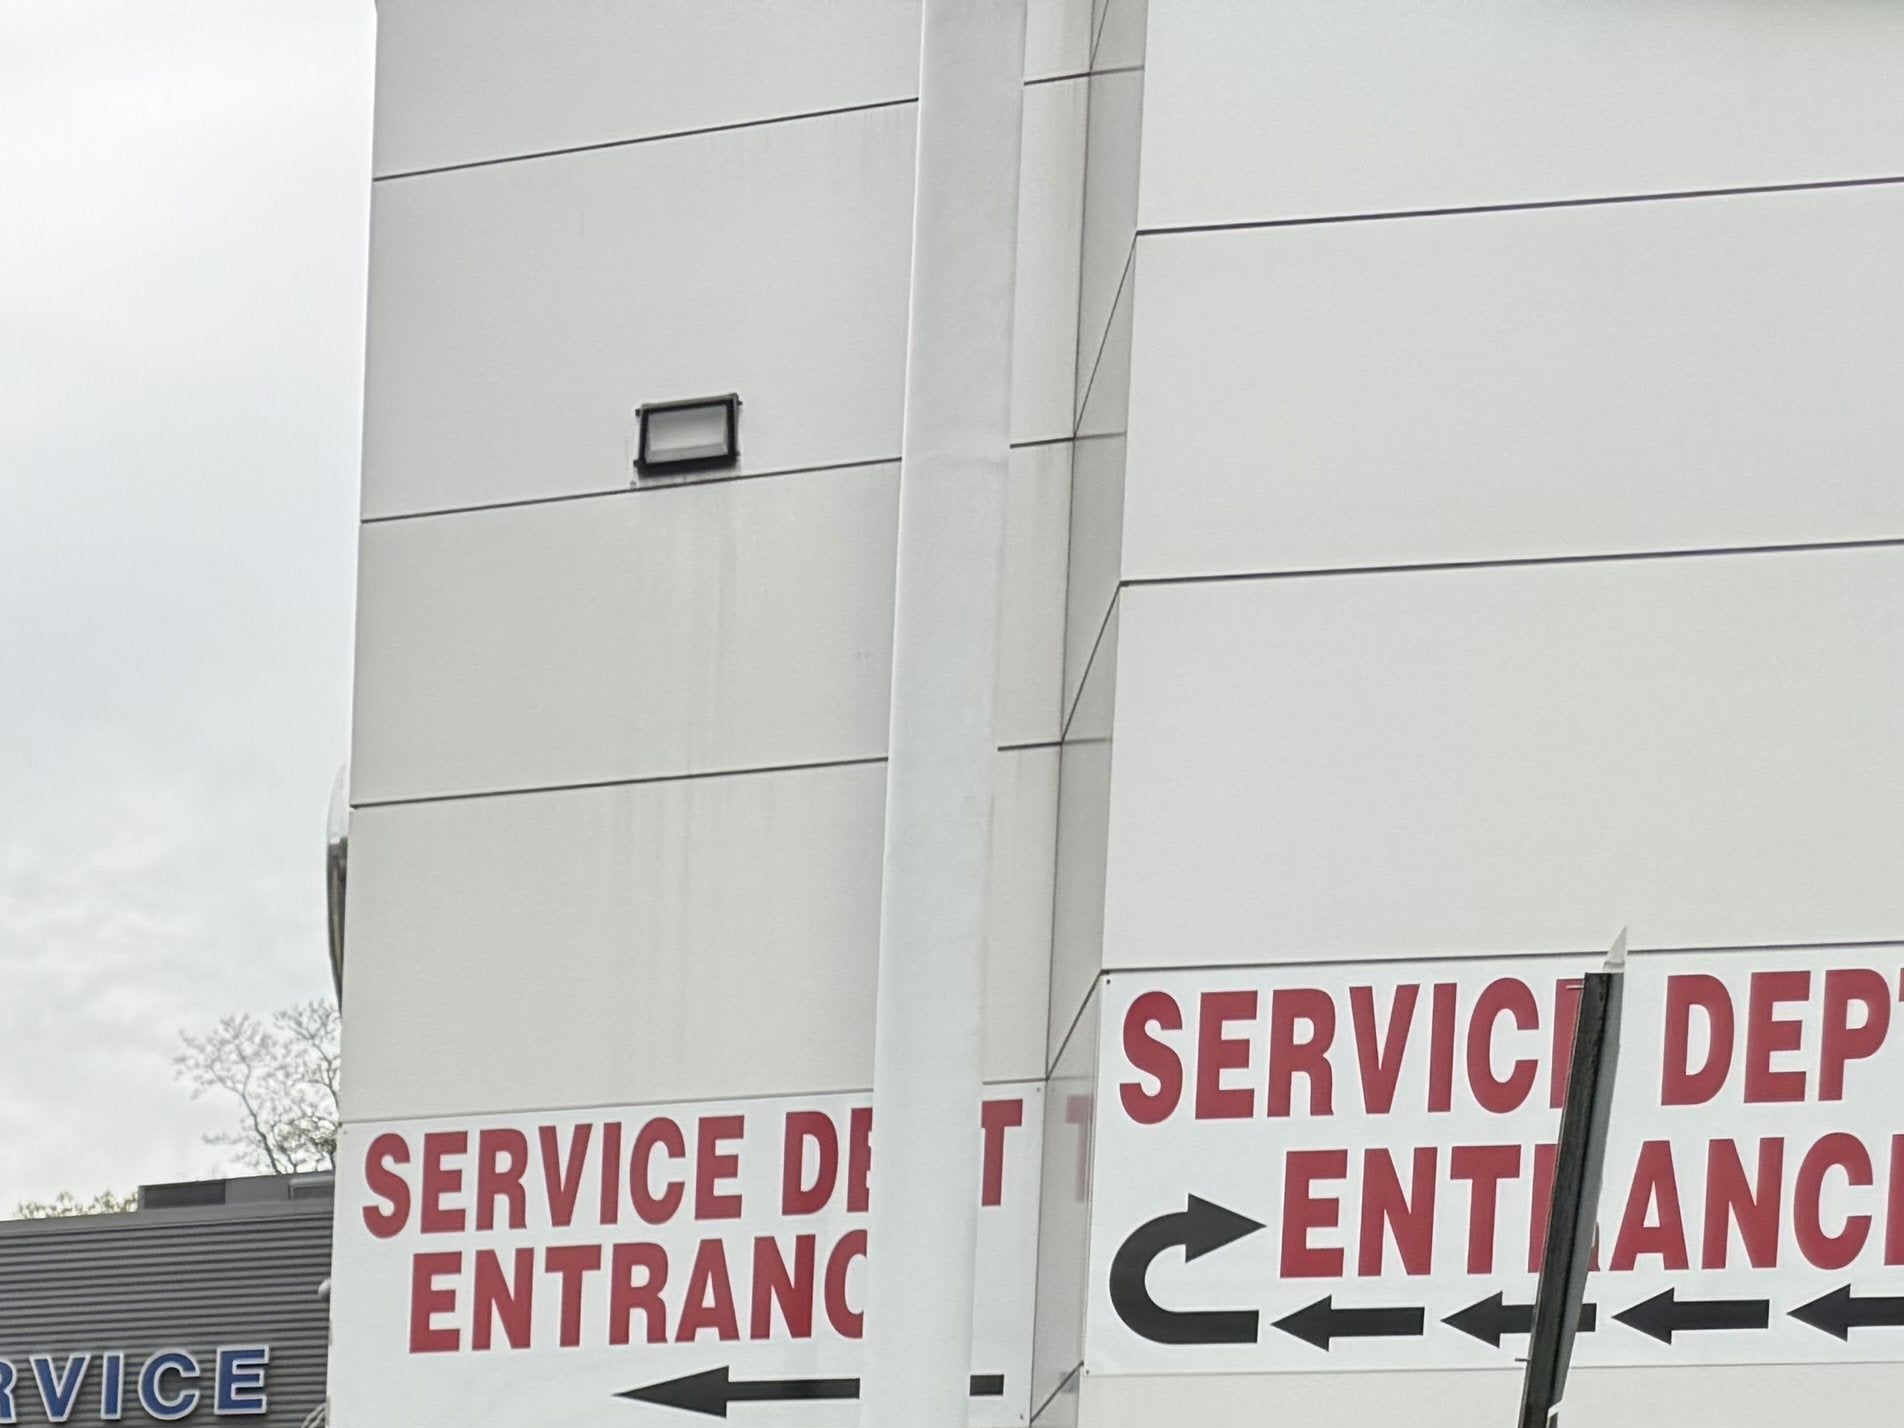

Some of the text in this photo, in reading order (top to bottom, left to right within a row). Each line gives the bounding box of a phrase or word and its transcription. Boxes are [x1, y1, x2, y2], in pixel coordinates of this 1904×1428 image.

[1660, 967, 1904, 1106] DEP
[361, 1098, 1023, 1239] SERVICE DET
[1280, 1131, 1904, 1279] ENTANC
[408, 1228, 868, 1354] ENTRANC
